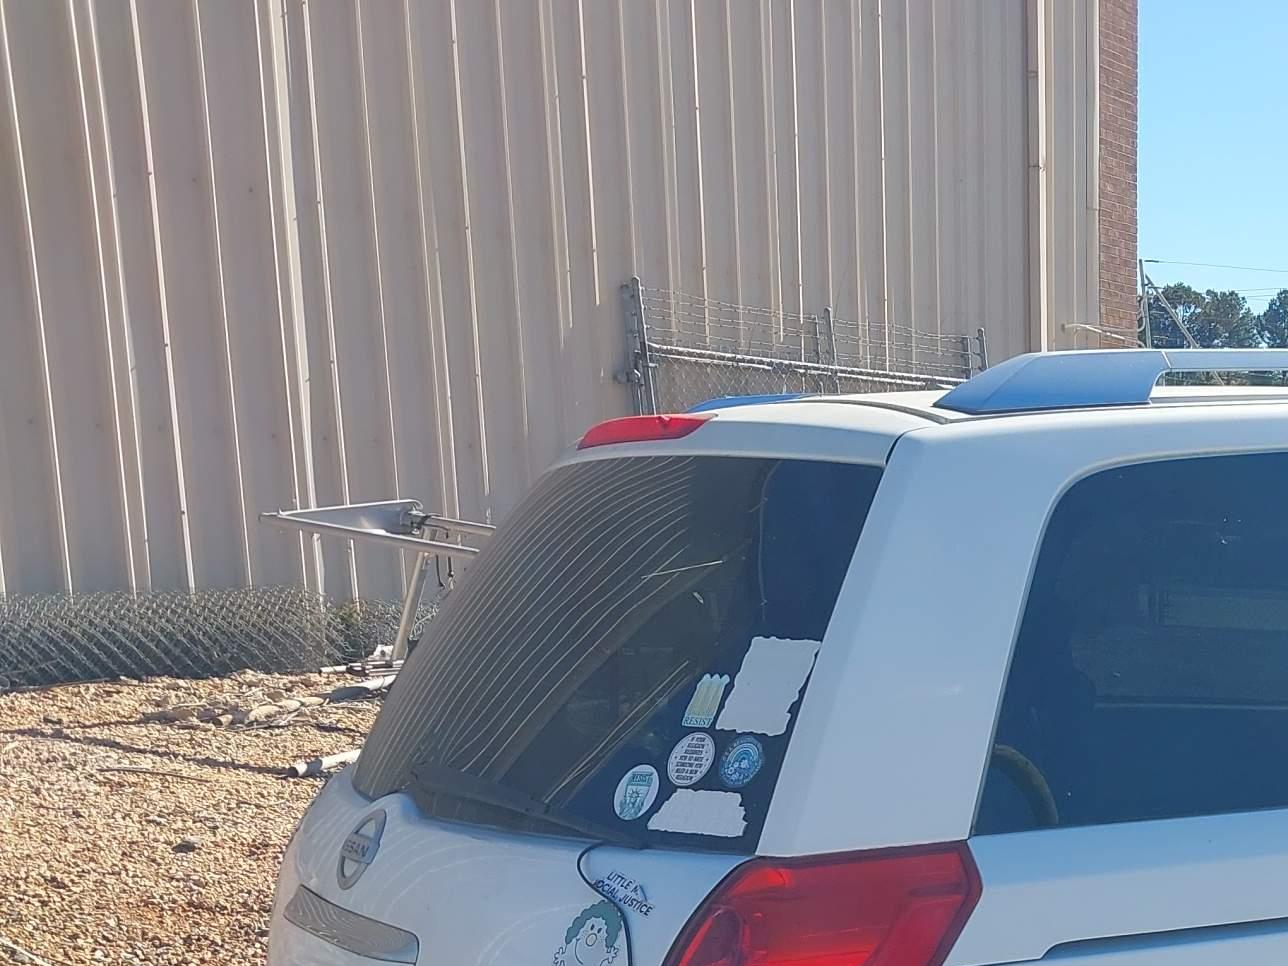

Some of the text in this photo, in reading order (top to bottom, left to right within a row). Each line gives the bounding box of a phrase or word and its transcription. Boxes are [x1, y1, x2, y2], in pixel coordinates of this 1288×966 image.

[683, 717, 712, 726] RESIST
[607, 871, 633, 890] LITTLE
[618, 894, 653, 916] JUSTICE
